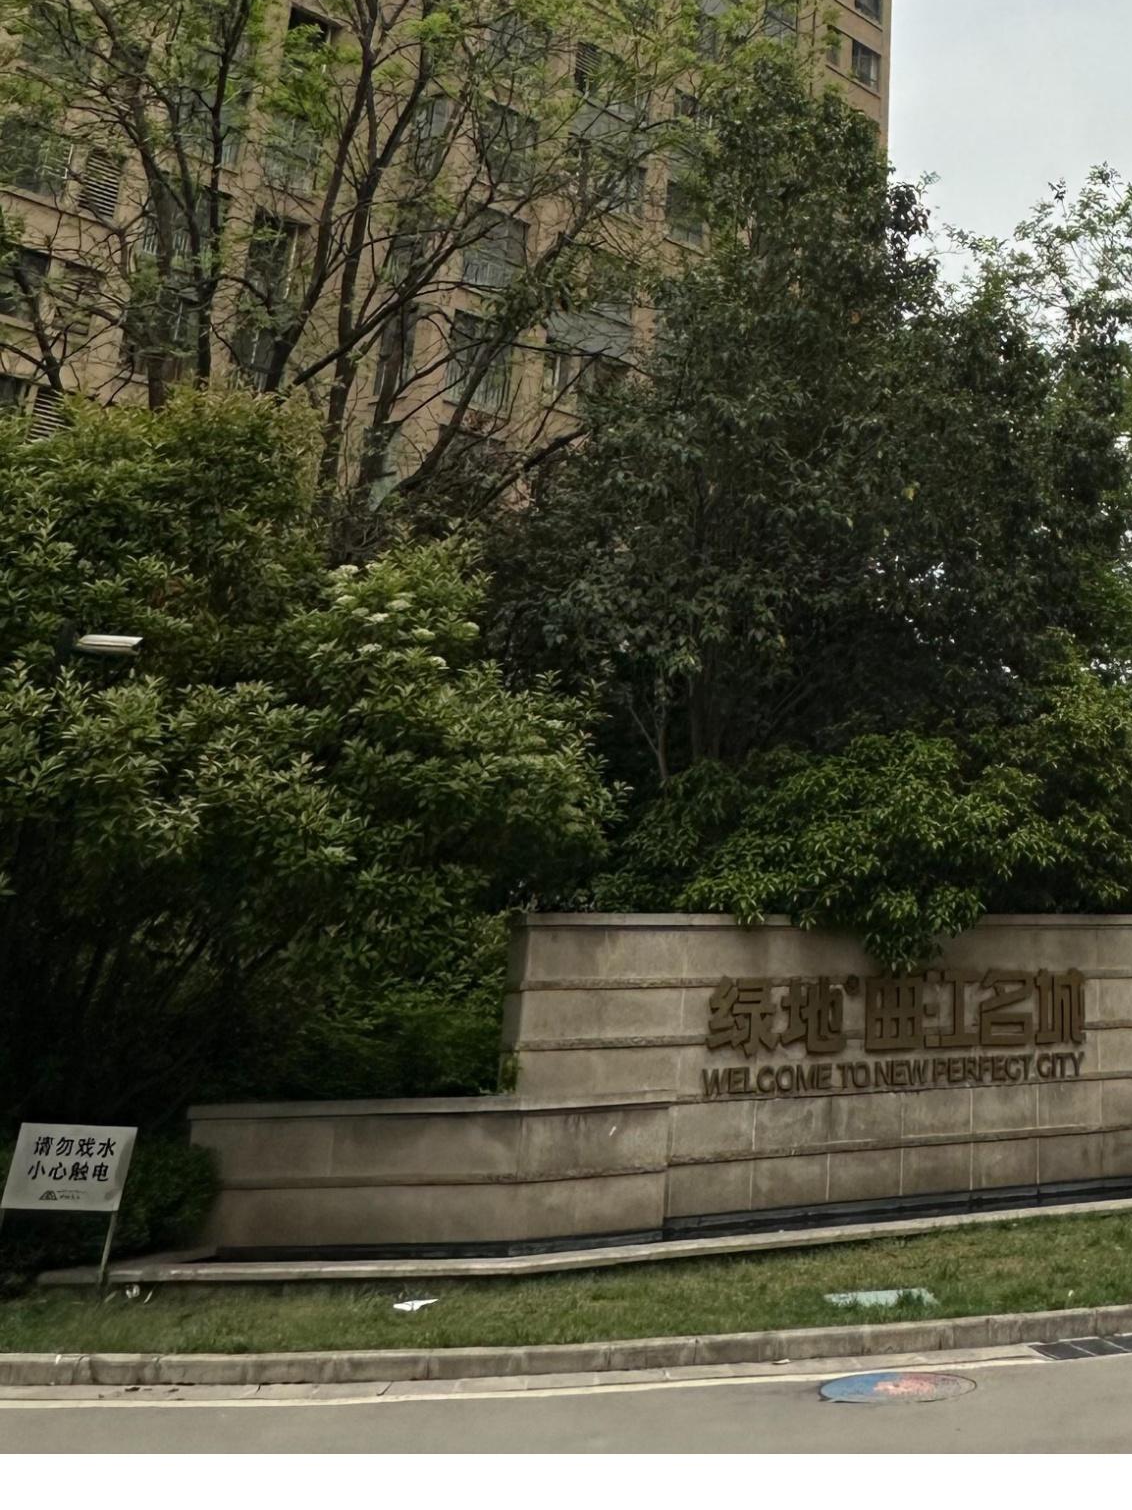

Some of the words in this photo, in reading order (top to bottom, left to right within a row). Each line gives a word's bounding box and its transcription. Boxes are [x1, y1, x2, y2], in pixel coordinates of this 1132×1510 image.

[706, 974, 848, 1059] 绿地
[702, 1063, 833, 1096] WELCOME
[837, 1061, 871, 1090] TO
[874, 1058, 930, 1088] NEW
[932, 1054, 1034, 1084] PERFECT
[1036, 1050, 1086, 1080] CITY
[33, 1136, 117, 1159] 请勿戏水
[27, 1160, 110, 1182] 小心触电
